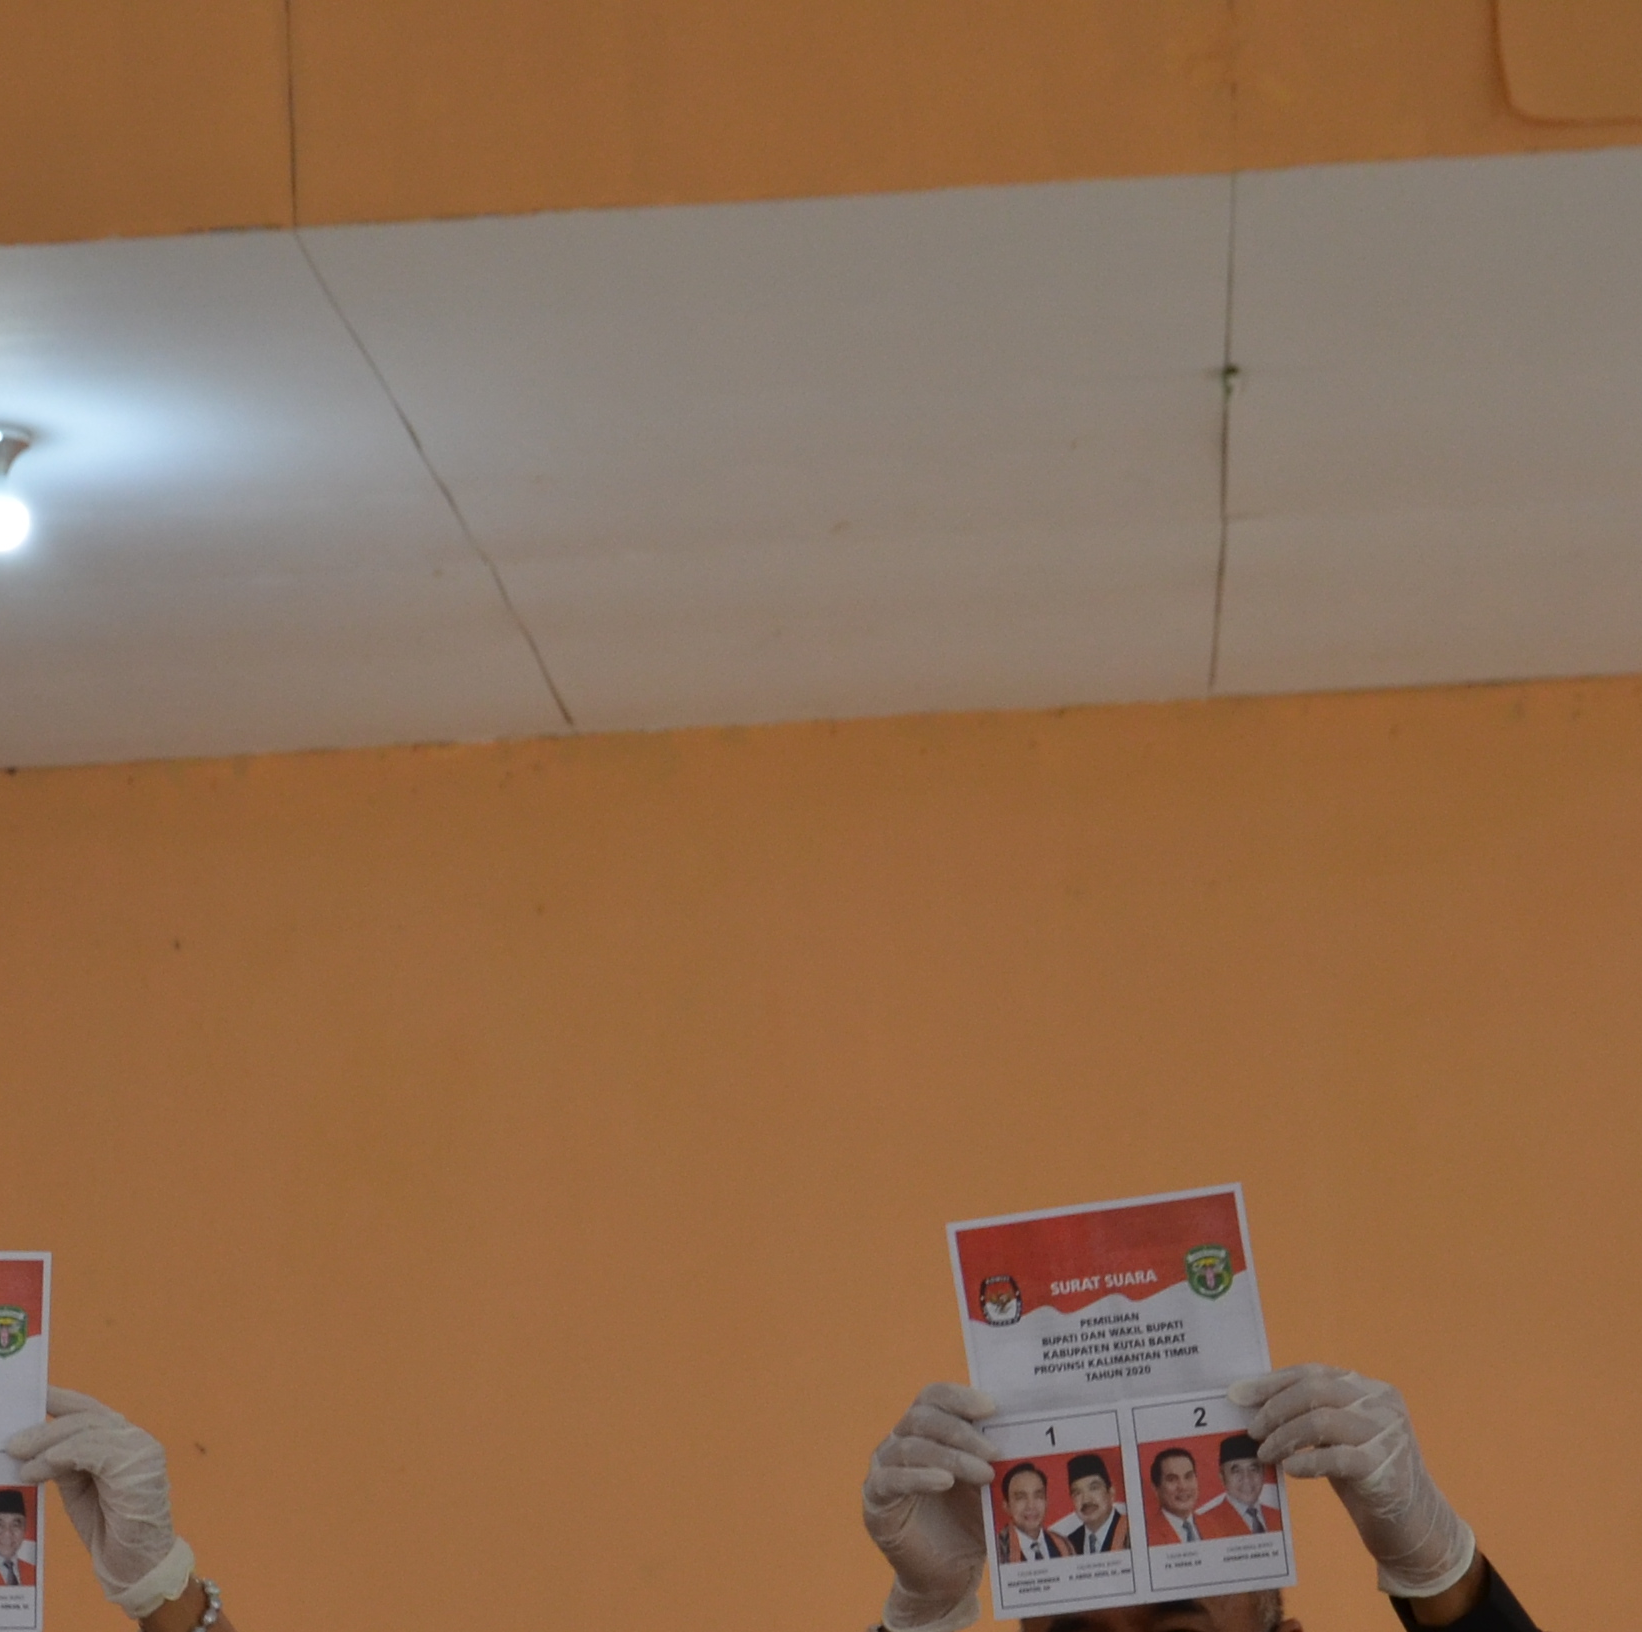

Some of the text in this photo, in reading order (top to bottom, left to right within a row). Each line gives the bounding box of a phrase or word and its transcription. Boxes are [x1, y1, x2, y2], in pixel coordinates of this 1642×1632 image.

[1051, 1269, 1157, 1296] SURAT SUARA
[1080, 1312, 1139, 1328] PEMILIHAN
[1042, 1321, 1183, 1346] BUPATI DAN WAKIL BUPATI
[1043, 1333, 1186, 1360] KABUPATEN KUTAI BARAT
[1034, 1345, 1198, 1375] PROVINSI KALIMANTAN TIMUR
[1086, 1366, 1151, 1382] TAHUN 2020
[1193, 1407, 1207, 1428] 2
[1045, 1426, 1057, 1447] 1
